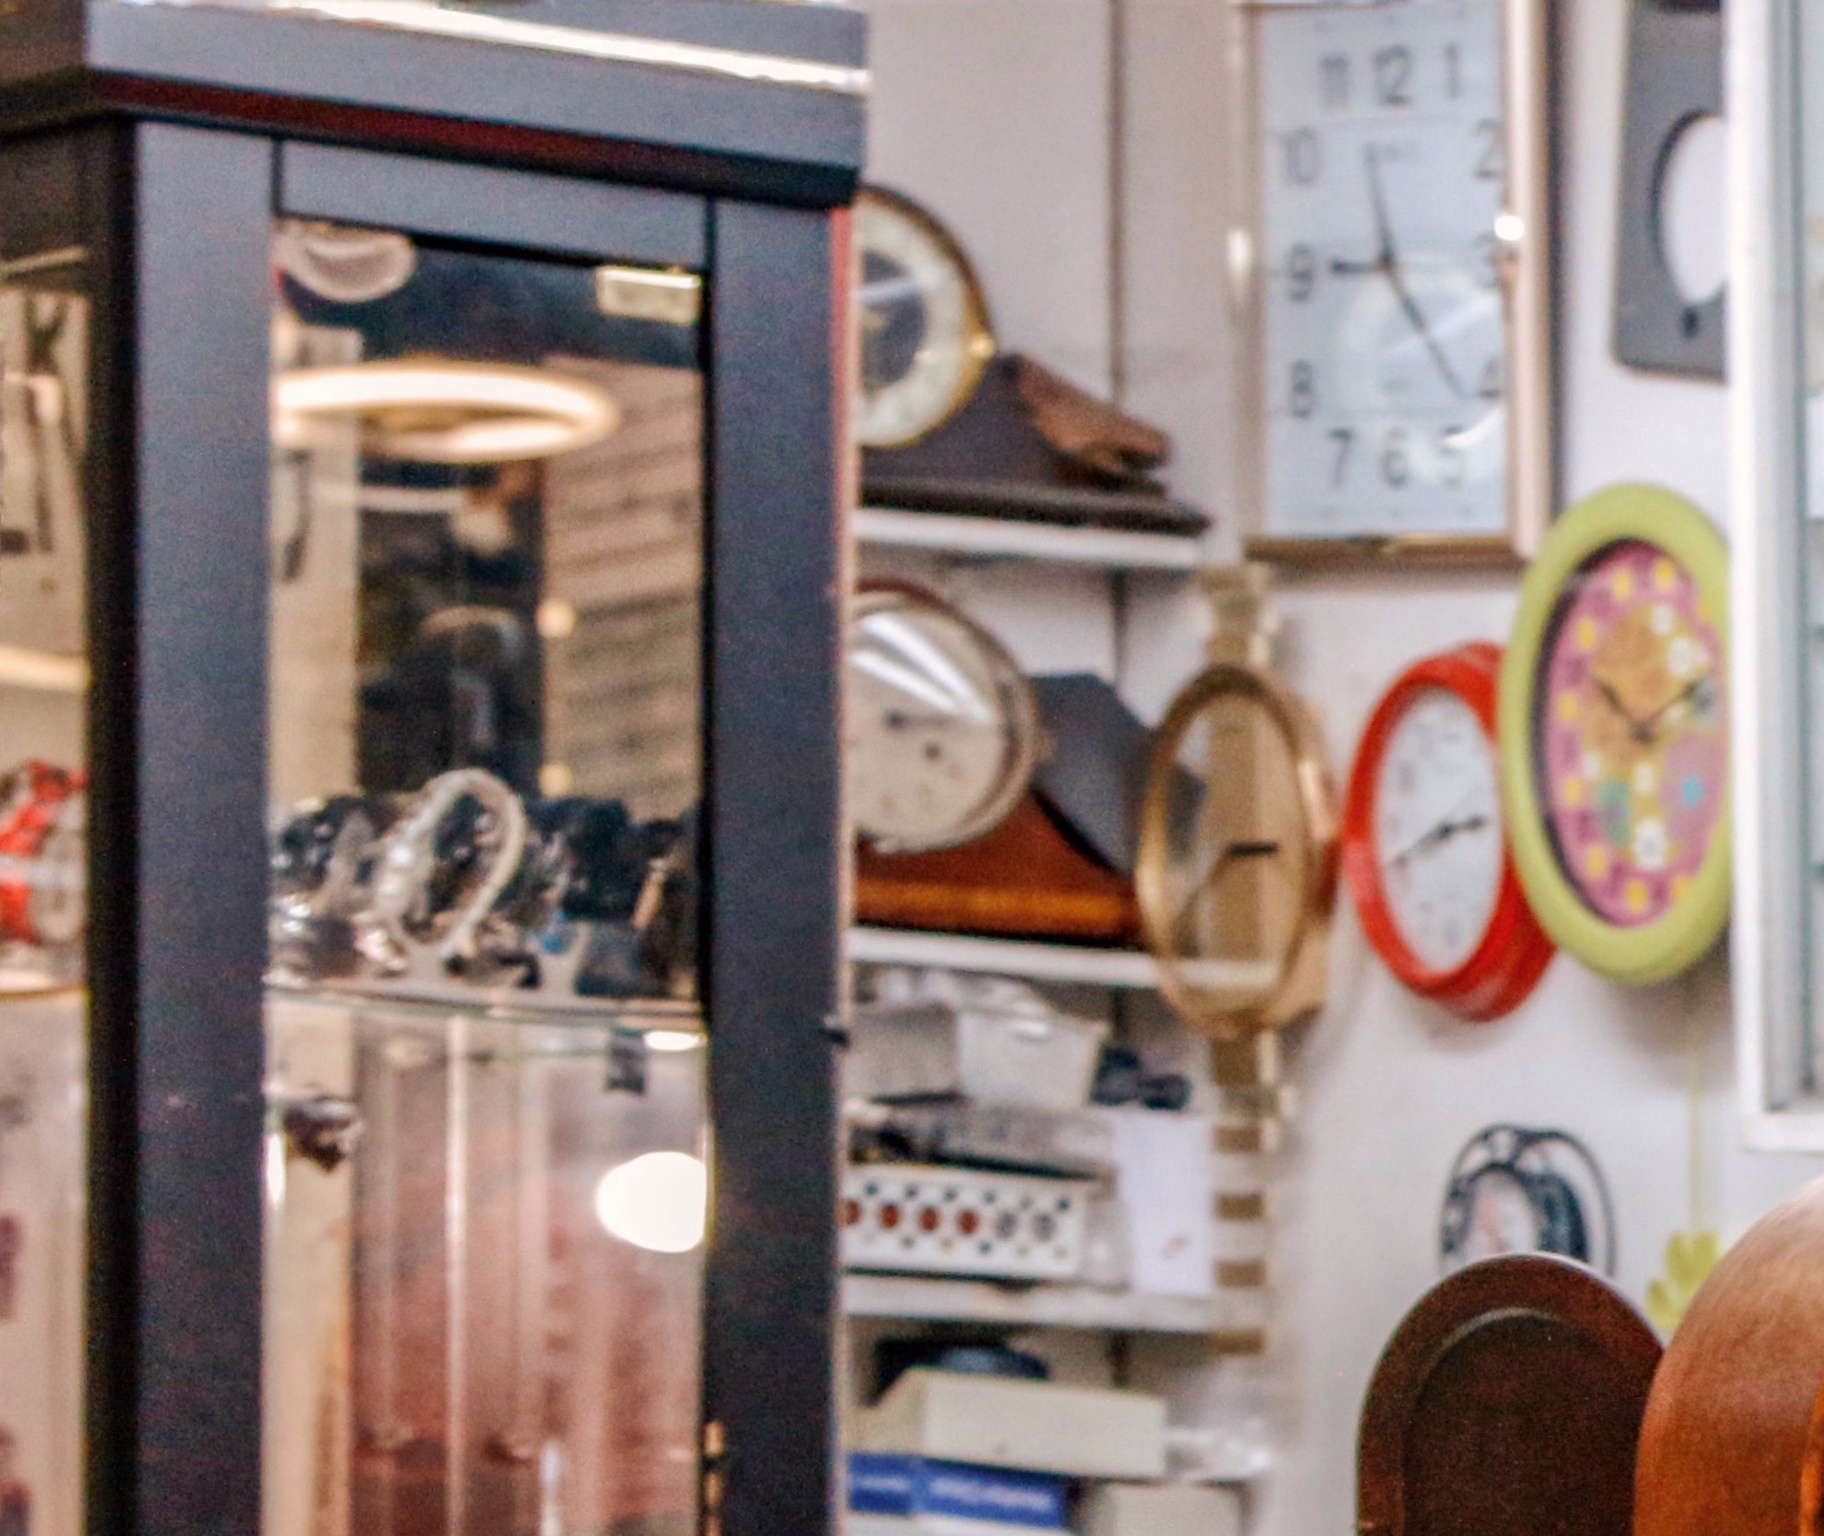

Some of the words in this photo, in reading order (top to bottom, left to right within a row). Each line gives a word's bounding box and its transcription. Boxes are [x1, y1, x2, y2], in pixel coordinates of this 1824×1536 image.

[1373, 43, 1412, 107] 12
[1445, 41, 1460, 99] 1
[1474, 119, 1499, 180] 2
[1288, 244, 1314, 303] 9
[1289, 359, 1316, 418] 8
[1329, 427, 1354, 487] 7
[1381, 427, 1408, 489] 6
